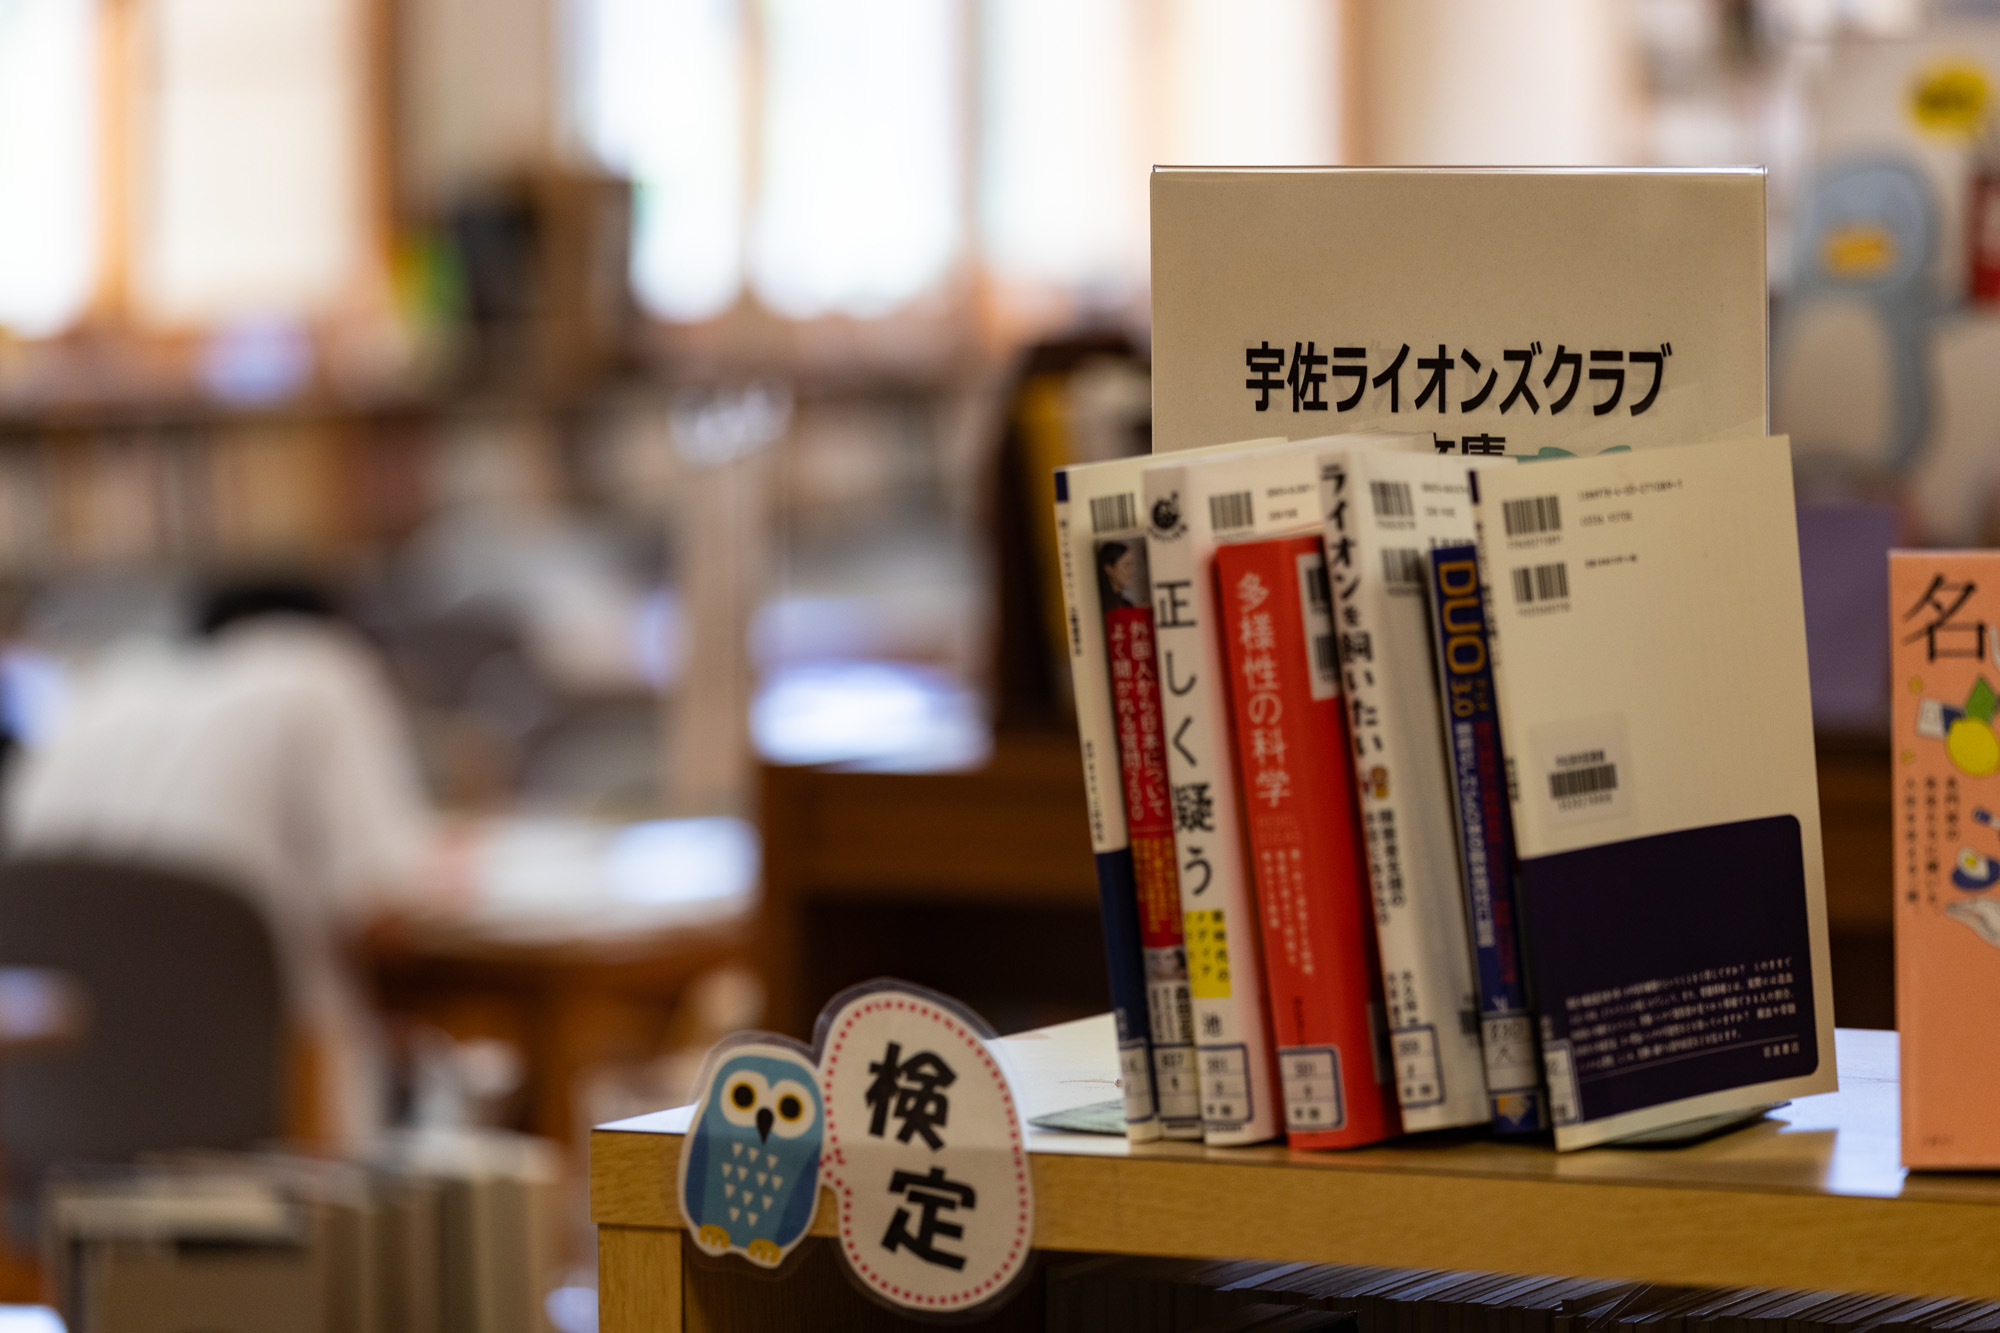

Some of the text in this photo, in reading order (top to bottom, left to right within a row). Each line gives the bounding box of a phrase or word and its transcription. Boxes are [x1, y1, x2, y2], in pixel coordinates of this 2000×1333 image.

[1245, 340, 1672, 417] 宇佐ライオンズクラブ
[1237, 571, 1291, 808] 多様性の科学
[1321, 464, 1383, 756] ライオンを飼いたい
[1438, 560, 1487, 675] DUO
[1902, 570, 1977, 672] 名
[1128, 619, 1165, 818] 外国人から日本について
[1155, 578, 1216, 898] 正しく疑う
[865, 1041, 977, 1272] 検定
